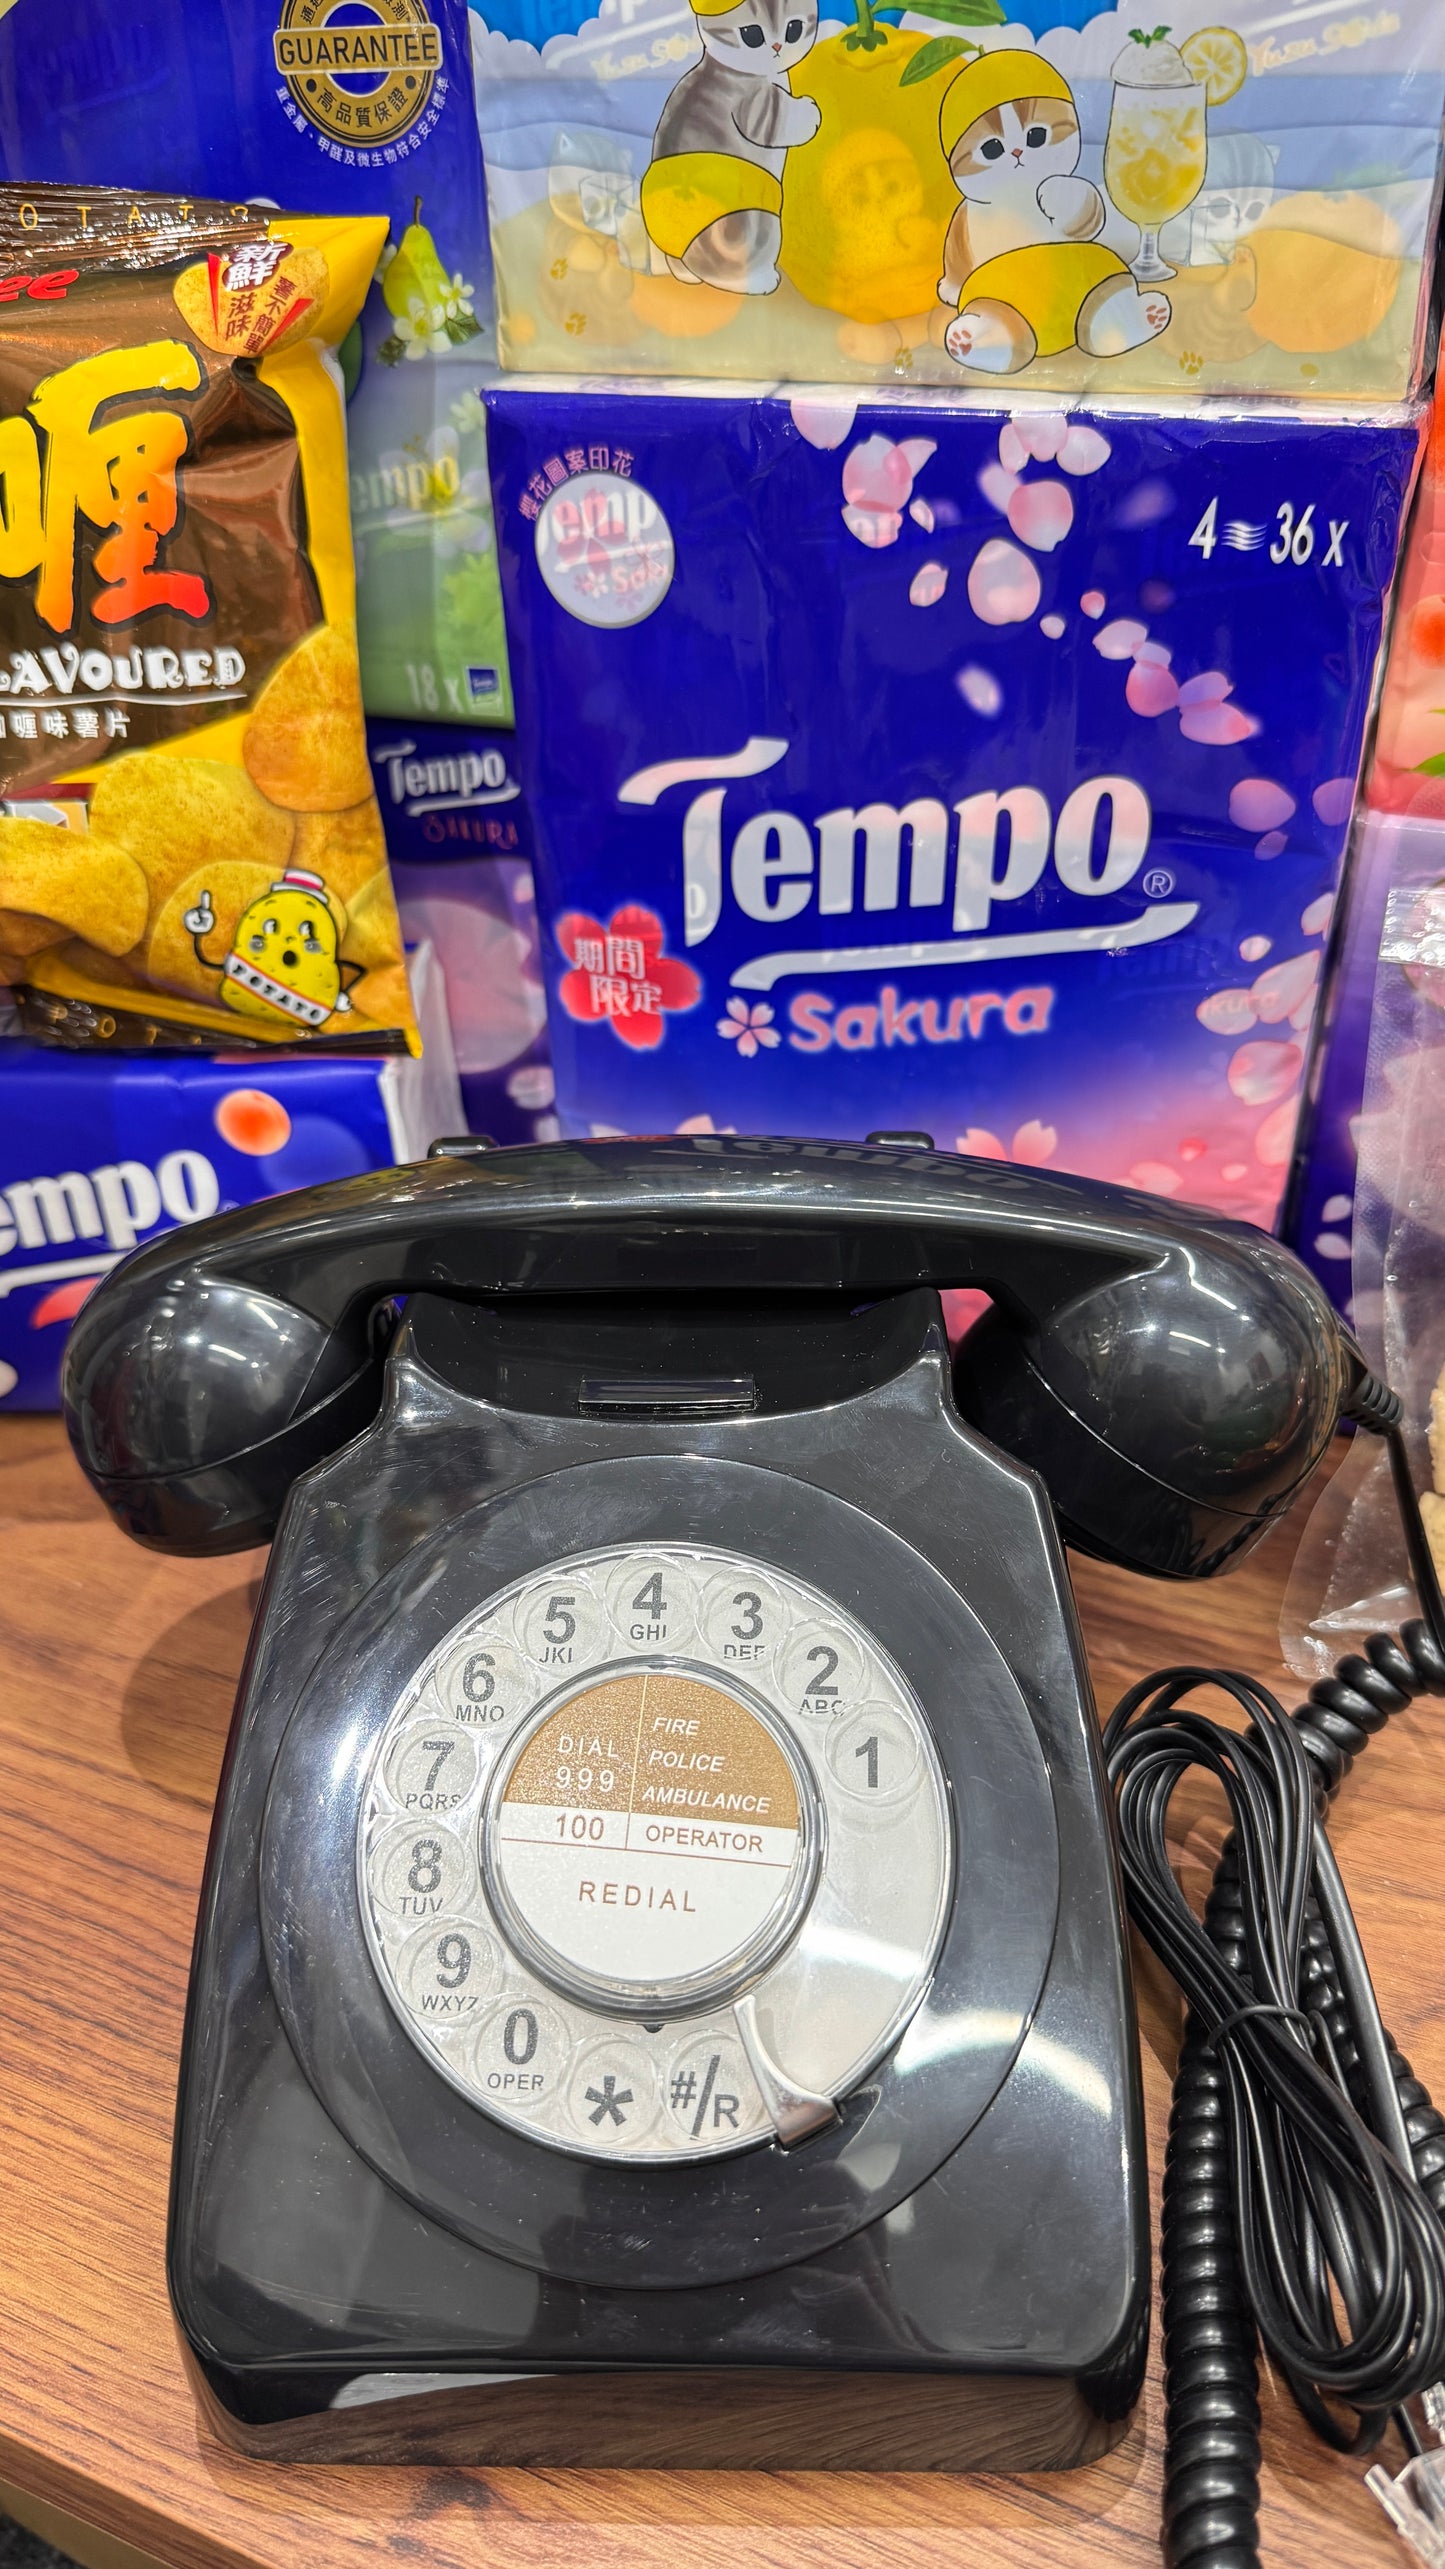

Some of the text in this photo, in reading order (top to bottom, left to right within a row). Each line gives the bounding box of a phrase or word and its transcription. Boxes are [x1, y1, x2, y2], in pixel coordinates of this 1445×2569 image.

[279, 33, 438, 66] GUARANTEE
[316, 87, 409, 128] 高品質保證
[224, 242, 288, 292] 新鮮
[1187, 496, 1219, 560] 4
[1269, 501, 1317, 566] 36
[405, 664, 440, 713] 18
[373, 740, 507, 804] Tempo
[617, 736, 1150, 948] Tempo
[573, 935, 646, 980] 期間
[231, 963, 321, 1020] POTATO
[589, 974, 663, 1018] 限定
[787, 985, 1056, 1053] Sakura
[543, 1596, 576, 1645] 5
[632, 1572, 667, 1620] 4
[731, 1591, 764, 1640] 3
[629, 1623, 667, 1641] GHI
[462, 1653, 496, 1702] 6
[805, 1645, 839, 1696] 2
[455, 1704, 505, 1722] MNO
[558, 1717, 701, 1758] DIAL FIRE
[422, 1741, 455, 1791] 7
[555, 1750, 725, 1793] 999 POLICE
[855, 1736, 878, 1788] 1
[405, 1792, 462, 1811] PQRS
[641, 1785, 772, 1814] AMBULANCE
[555, 1812, 763, 1853] 100 OPERATOR
[408, 1839, 443, 1893] 8
[399, 1896, 444, 1916] TUV
[578, 1880, 697, 1912] REDIAL
[436, 1932, 472, 1989] 9
[503, 2008, 538, 2065] 0
[487, 2072, 545, 2091] OPER
